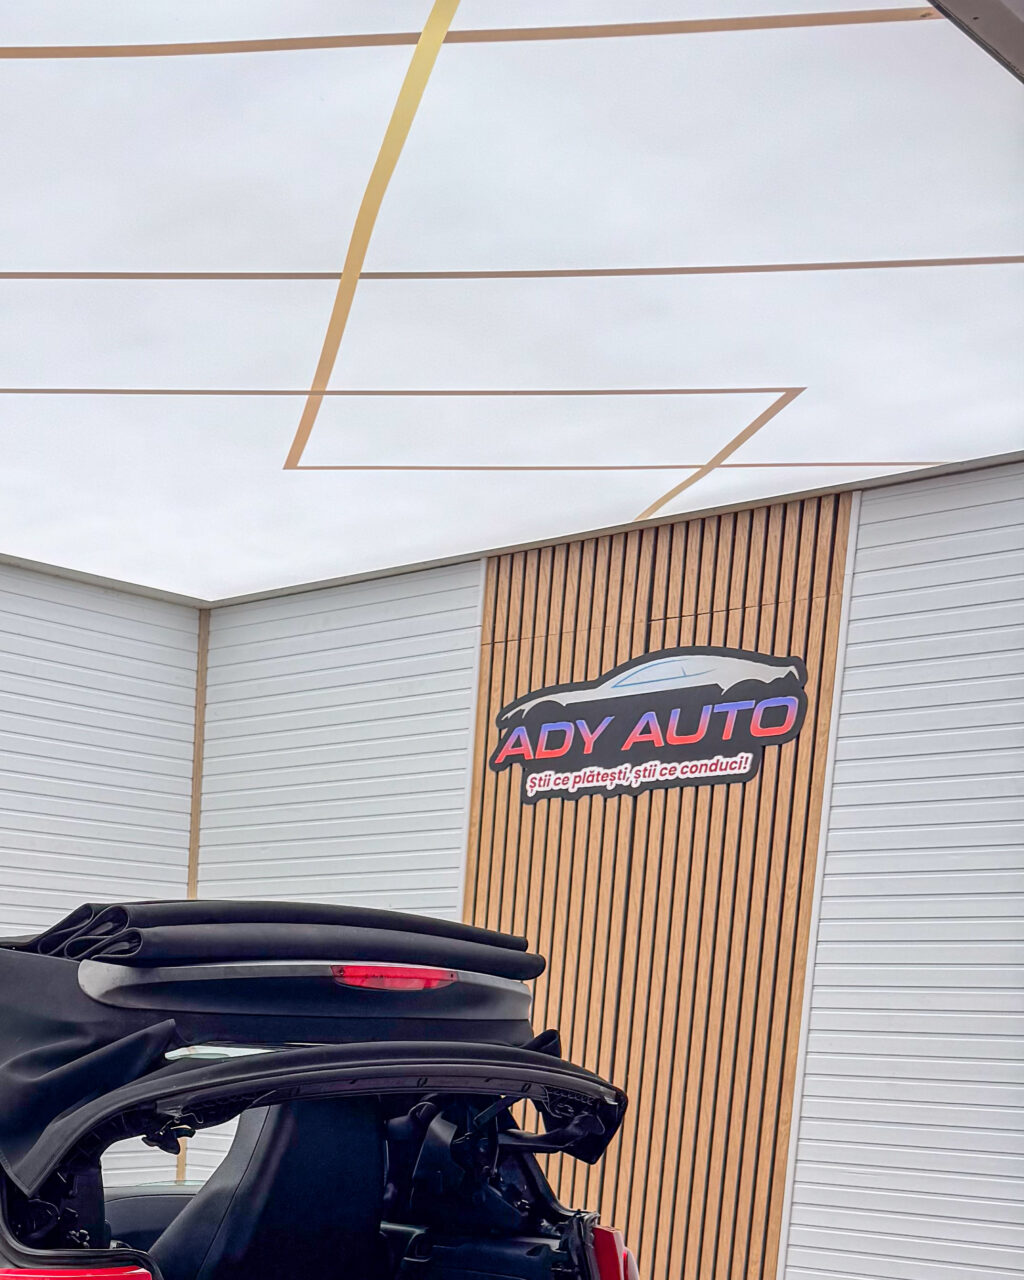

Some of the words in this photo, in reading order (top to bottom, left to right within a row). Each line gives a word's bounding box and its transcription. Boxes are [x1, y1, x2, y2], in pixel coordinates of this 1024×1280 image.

[494, 715, 615, 764] ADY
[621, 696, 798, 751] AUTO
[529, 774, 552, 793] Știi
[553, 775, 570, 787] ce
[571, 767, 631, 789] plătești,
[634, 764, 657, 784] știi
[659, 765, 677, 777] ce
[680, 755, 750, 775] conduci!
